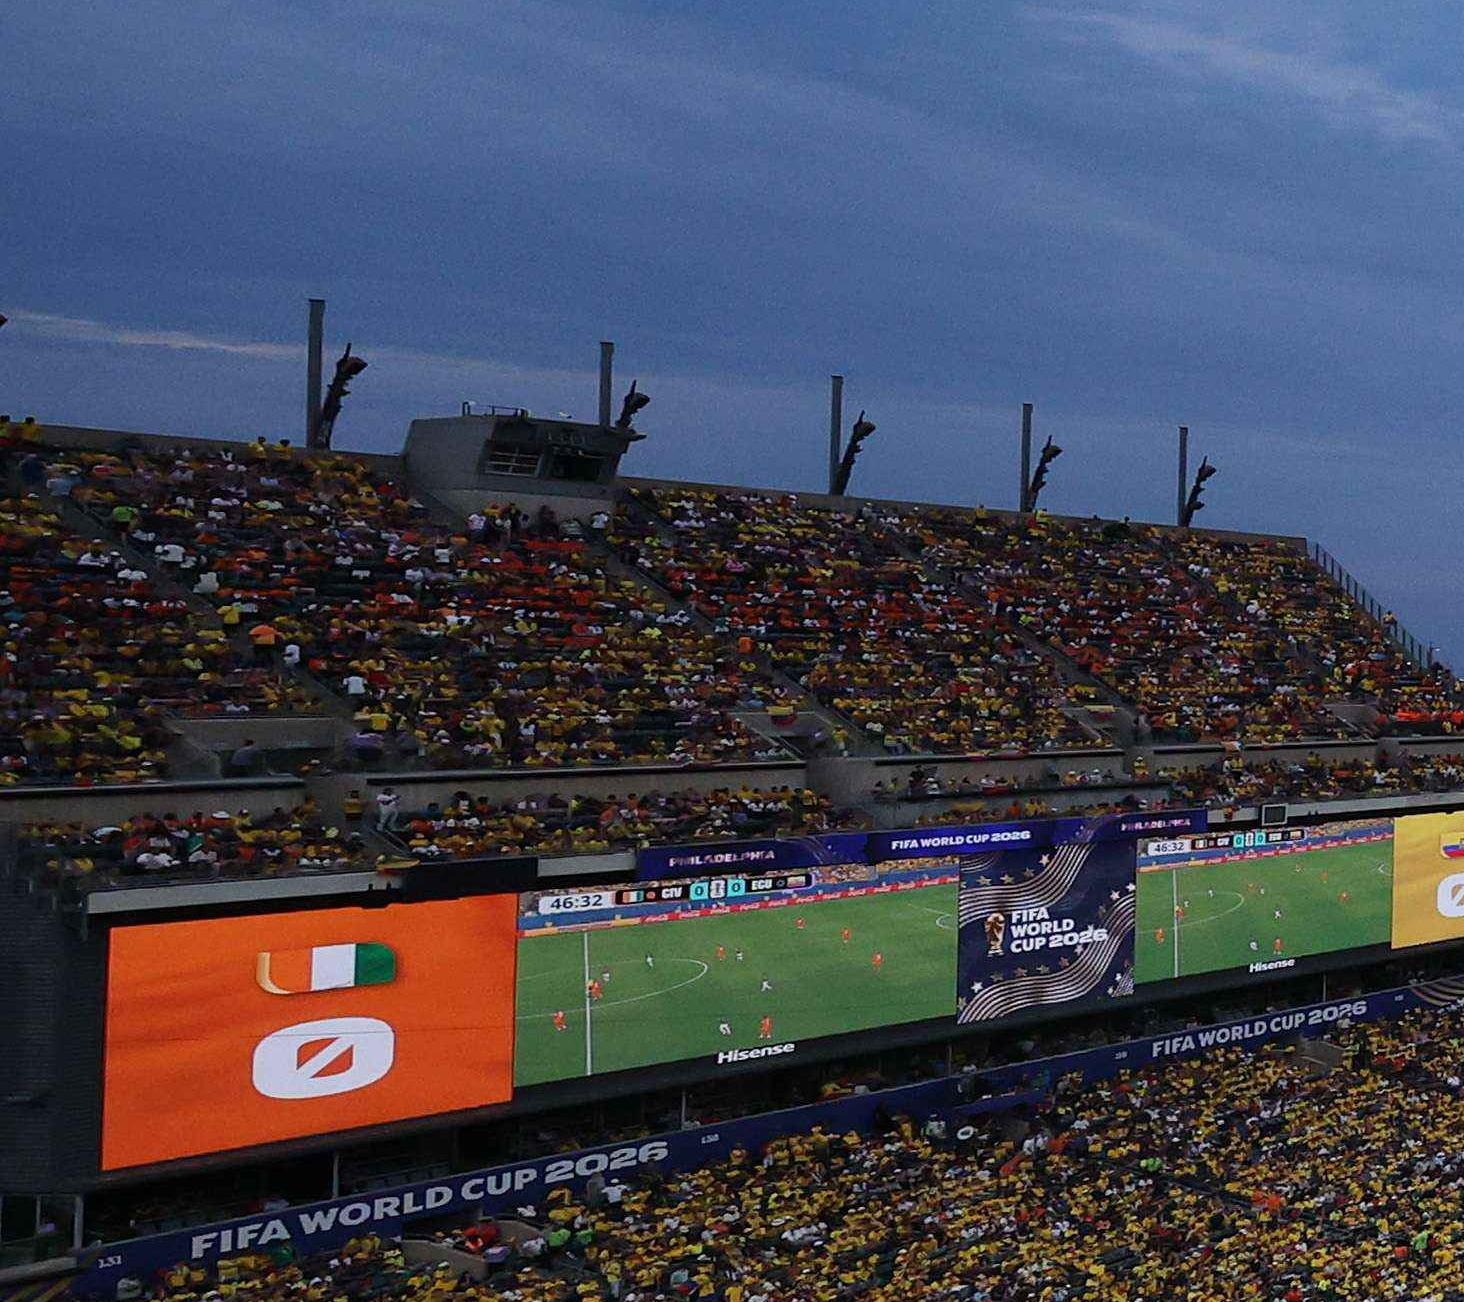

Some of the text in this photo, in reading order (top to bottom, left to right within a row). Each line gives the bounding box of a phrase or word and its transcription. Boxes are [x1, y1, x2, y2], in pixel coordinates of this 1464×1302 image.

[891, 830, 1031, 850] FIFA WORLD CUP 2026
[669, 849, 775, 868] PHILADELPHIA
[550, 878, 772, 911] 46:32 ECU
[1012, 907, 1049, 924] FIFA
[1011, 919, 1075, 938] WORLD
[1011, 927, 1109, 954] CUP 2026
[1249, 957, 1296, 974] Hisense
[1152, 999, 1368, 1058] FIFA WORLD CUP 2026
[717, 1041, 795, 1065] Hisense
[191, 1141, 669, 1260] FIFA WORLD CUP 2026
